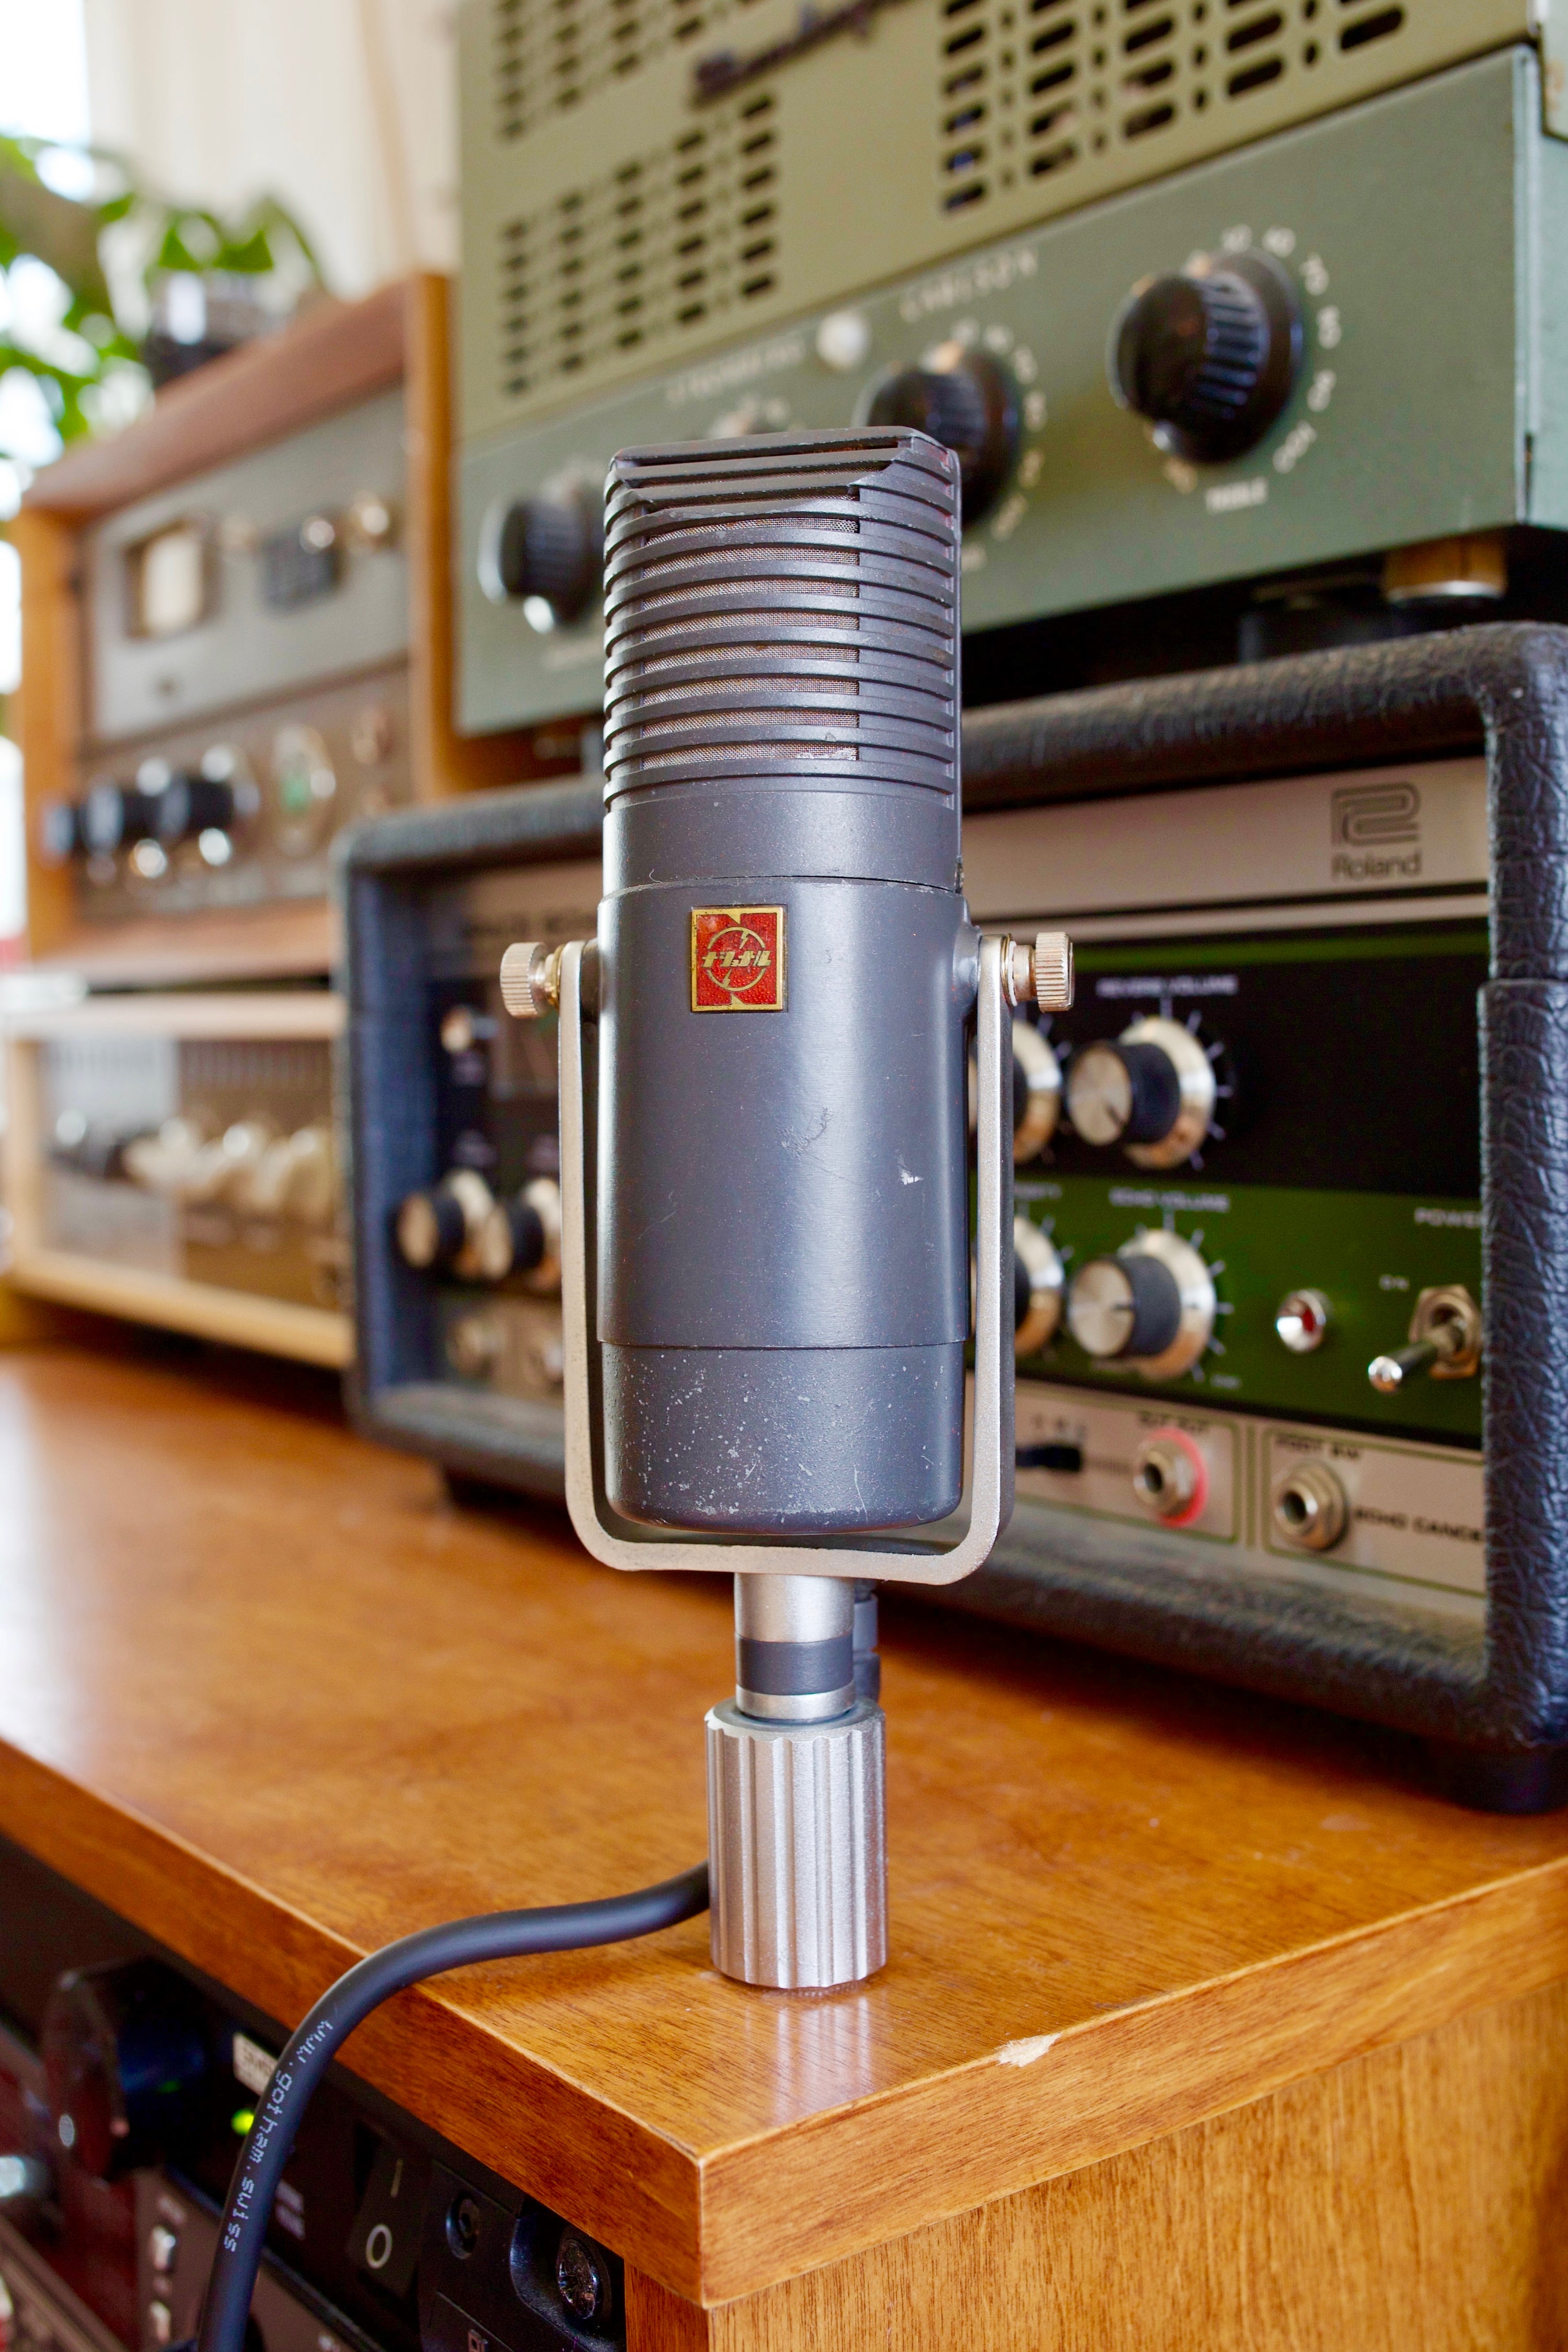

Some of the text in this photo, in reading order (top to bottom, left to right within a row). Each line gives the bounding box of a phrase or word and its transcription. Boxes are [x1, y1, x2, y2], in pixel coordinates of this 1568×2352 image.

[1332, 849, 1422, 880] Roland
[1160, 1190, 1230, 1213] VOLUME
[224, 2020, 333, 2253] www.gotham.swiss
